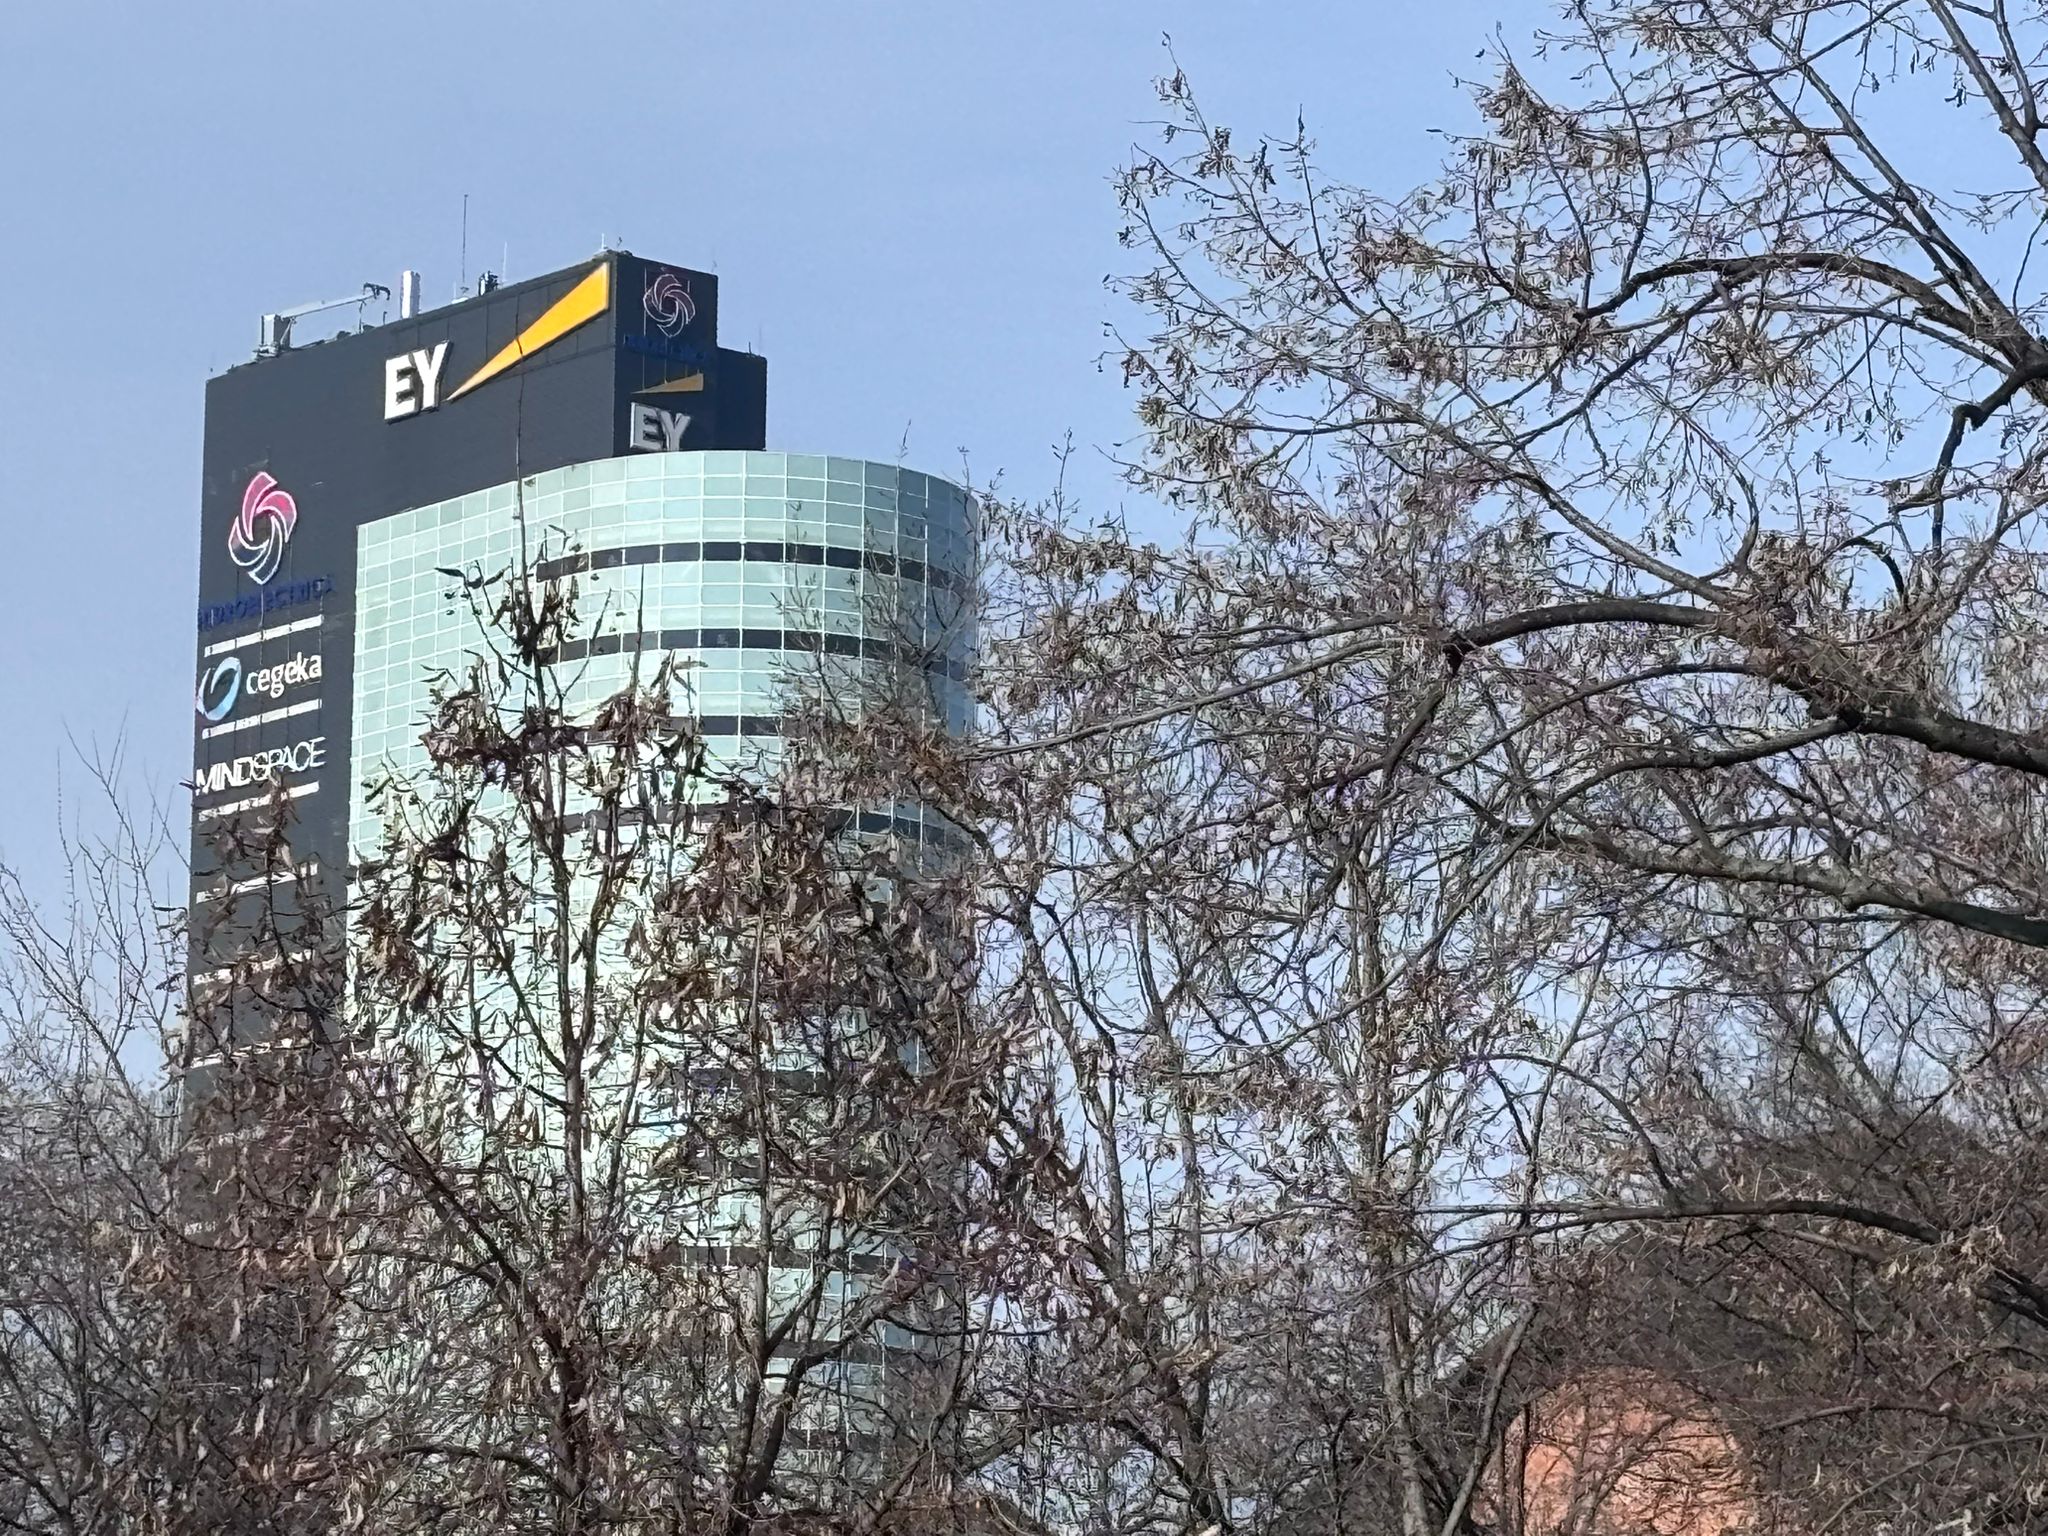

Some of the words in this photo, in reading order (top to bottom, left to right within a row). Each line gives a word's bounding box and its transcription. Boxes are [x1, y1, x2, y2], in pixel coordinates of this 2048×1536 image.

[385, 340, 450, 420] EY
[630, 402, 691, 451] EY
[246, 652, 322, 698] cegeka
[196, 737, 326, 796] MINDSPACE
